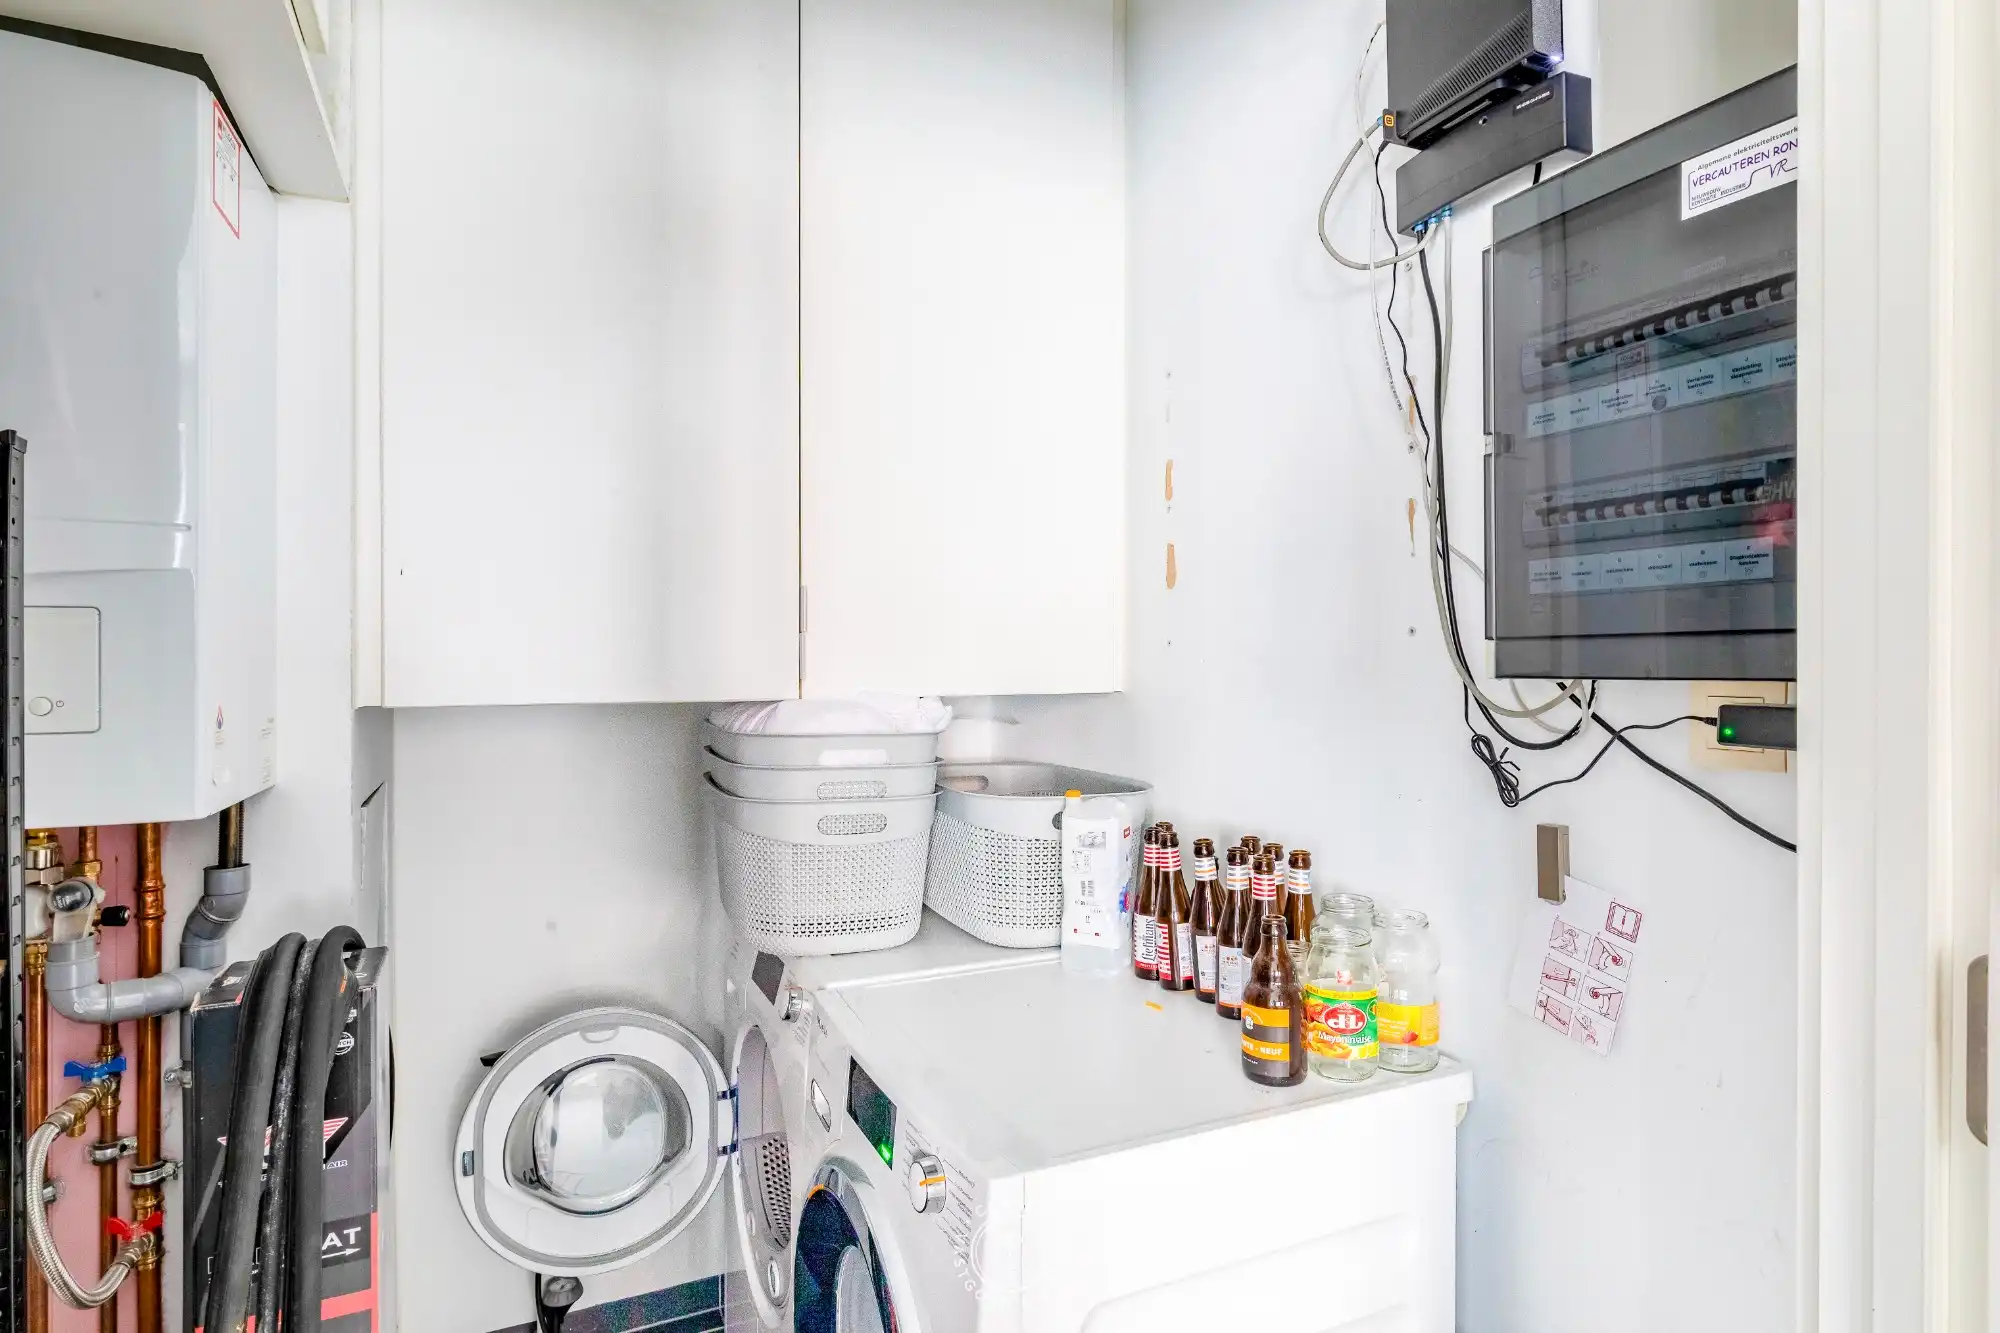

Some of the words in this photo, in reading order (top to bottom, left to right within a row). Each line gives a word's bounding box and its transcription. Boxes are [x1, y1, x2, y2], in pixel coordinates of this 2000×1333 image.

[1692, 149, 1770, 188] VERCAUTEREN
[1318, 1029, 1373, 1045] Mayonnaise
[326, 1159, 348, 1170] AIR
[322, 1226, 362, 1251] AT
